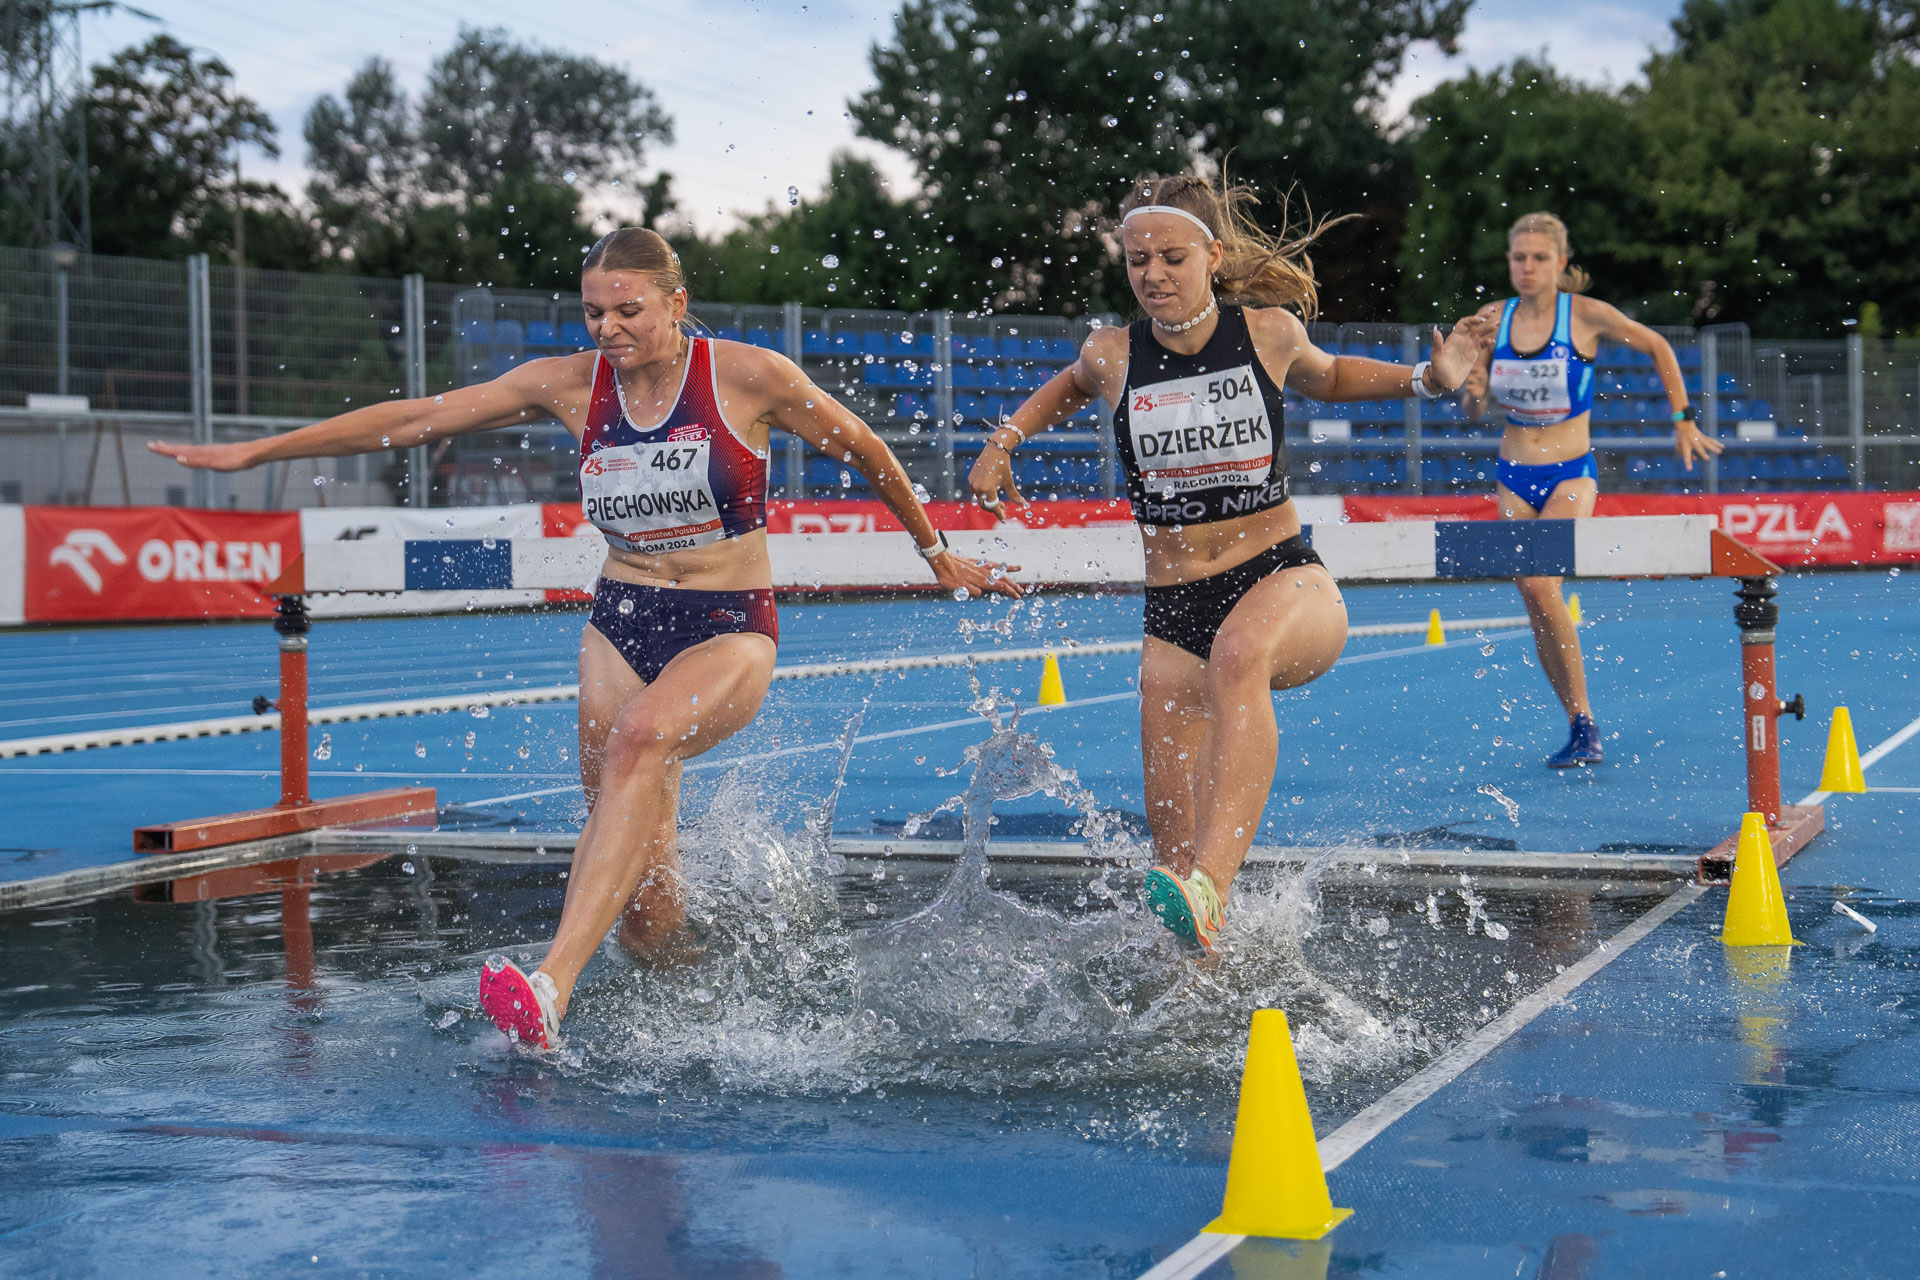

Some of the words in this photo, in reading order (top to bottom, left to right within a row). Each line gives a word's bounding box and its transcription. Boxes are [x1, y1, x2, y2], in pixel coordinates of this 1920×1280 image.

[1531, 364, 1560, 379] 523
[1208, 374, 1254, 404] 504
[1138, 415, 1268, 458] DZIERŻEK
[651, 448, 698, 472] 467
[1230, 459, 1251, 470] Polski
[1252, 458, 1266, 468] U20
[1173, 476, 1219, 490] RADOM
[1221, 474, 1250, 484] 2024
[587, 488, 713, 521] PIECHOWSKA
[1146, 501, 1207, 521] PRO
[1222, 481, 1282, 515] NIKE
[630, 530, 673, 542] Mistrzostwa
[675, 526, 696, 537] Polski
[697, 523, 712, 532] U20
[1722, 503, 1853, 542] PZLA
[625, 541, 666, 553] RADOM
[667, 538, 696, 550] 2024
[137, 539, 281, 582] ORLEN
